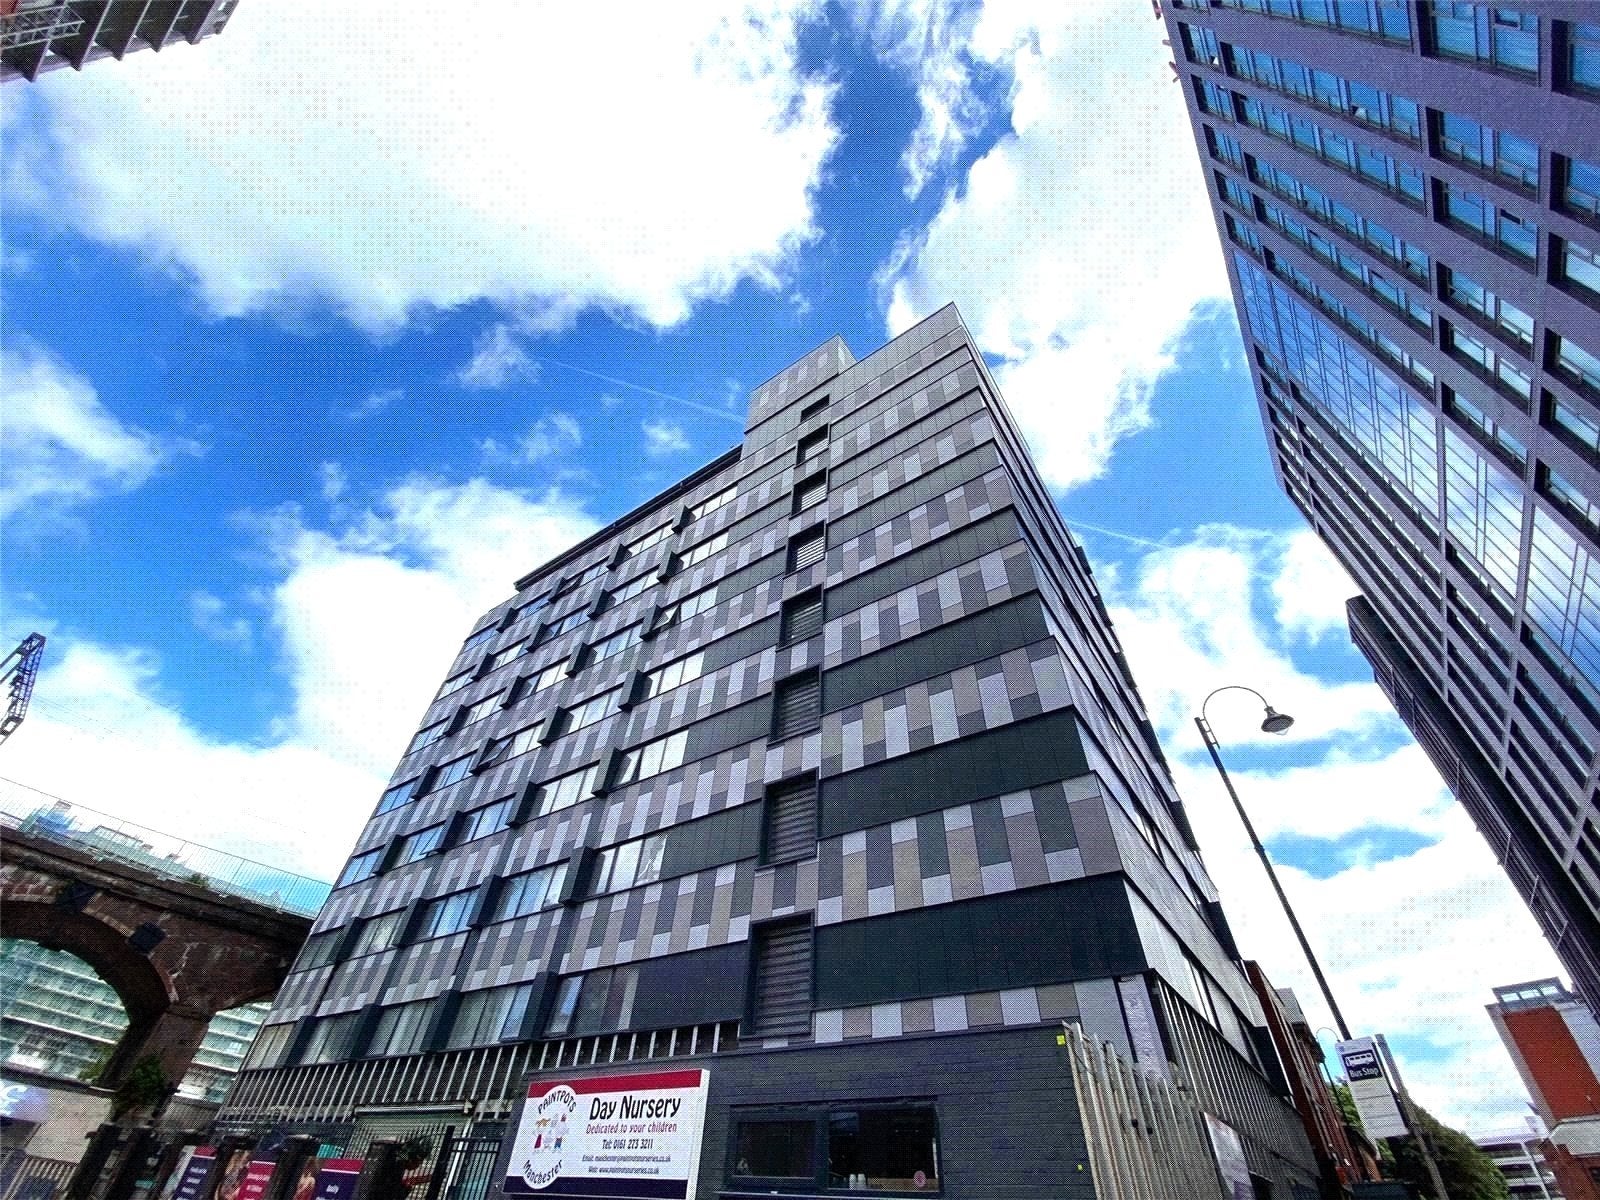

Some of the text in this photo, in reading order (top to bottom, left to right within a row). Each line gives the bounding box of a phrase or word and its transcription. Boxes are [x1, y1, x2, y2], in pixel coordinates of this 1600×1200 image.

[1349, 1067, 1379, 1078] Bus Stop
[538, 1090, 576, 1114] PAINTPOTS
[590, 1095, 681, 1120] Day Nursery
[586, 1121, 677, 1134] Dedicated to your children
[602, 1139, 654, 1150] Tel: 0161 273 3211
[523, 1159, 563, 1184] Manchester
